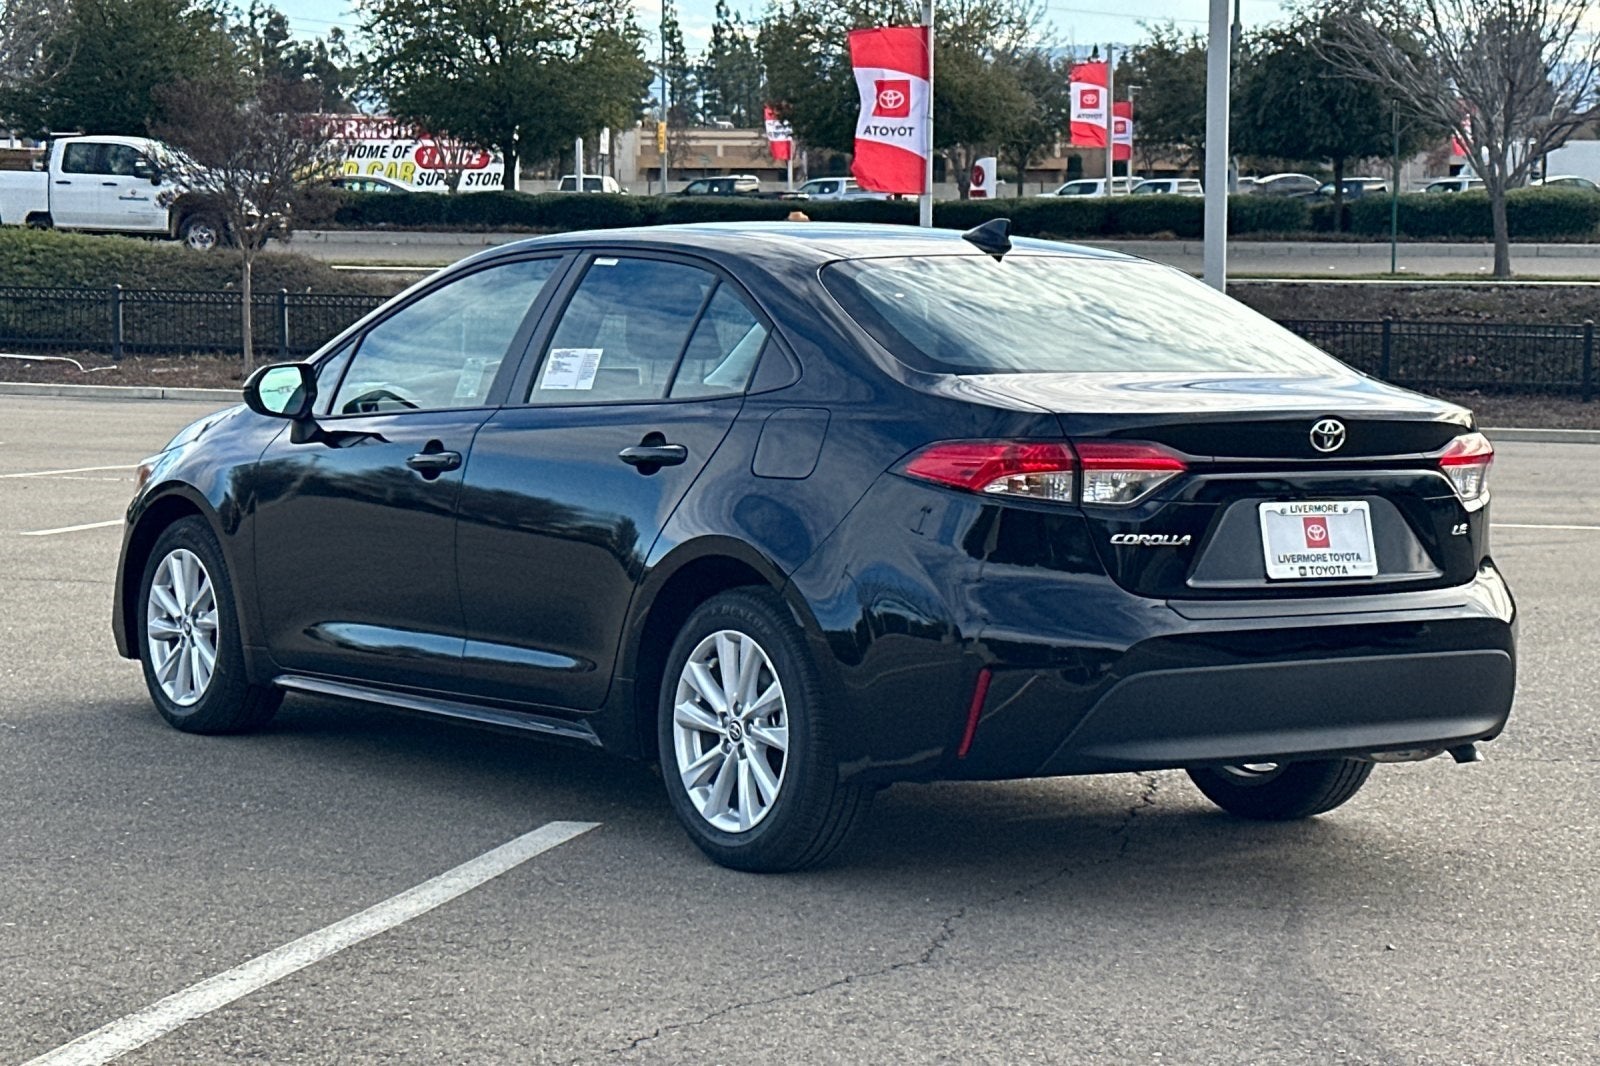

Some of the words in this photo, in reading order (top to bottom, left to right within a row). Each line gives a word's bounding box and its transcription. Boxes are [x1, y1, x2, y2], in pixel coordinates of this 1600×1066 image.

[347, 145, 387, 158] HOME
[392, 145, 412, 158] OF
[416, 172, 456, 186] SUP
[465, 172, 504, 186] STOR
[1290, 504, 1338, 513] LIVERMORE
[1110, 533, 1191, 546] COROLLA
[1278, 554, 1328, 564] LIVERMORE
[1330, 552, 1362, 562] TOYOTA
[1309, 565, 1349, 576] TOYOTA
